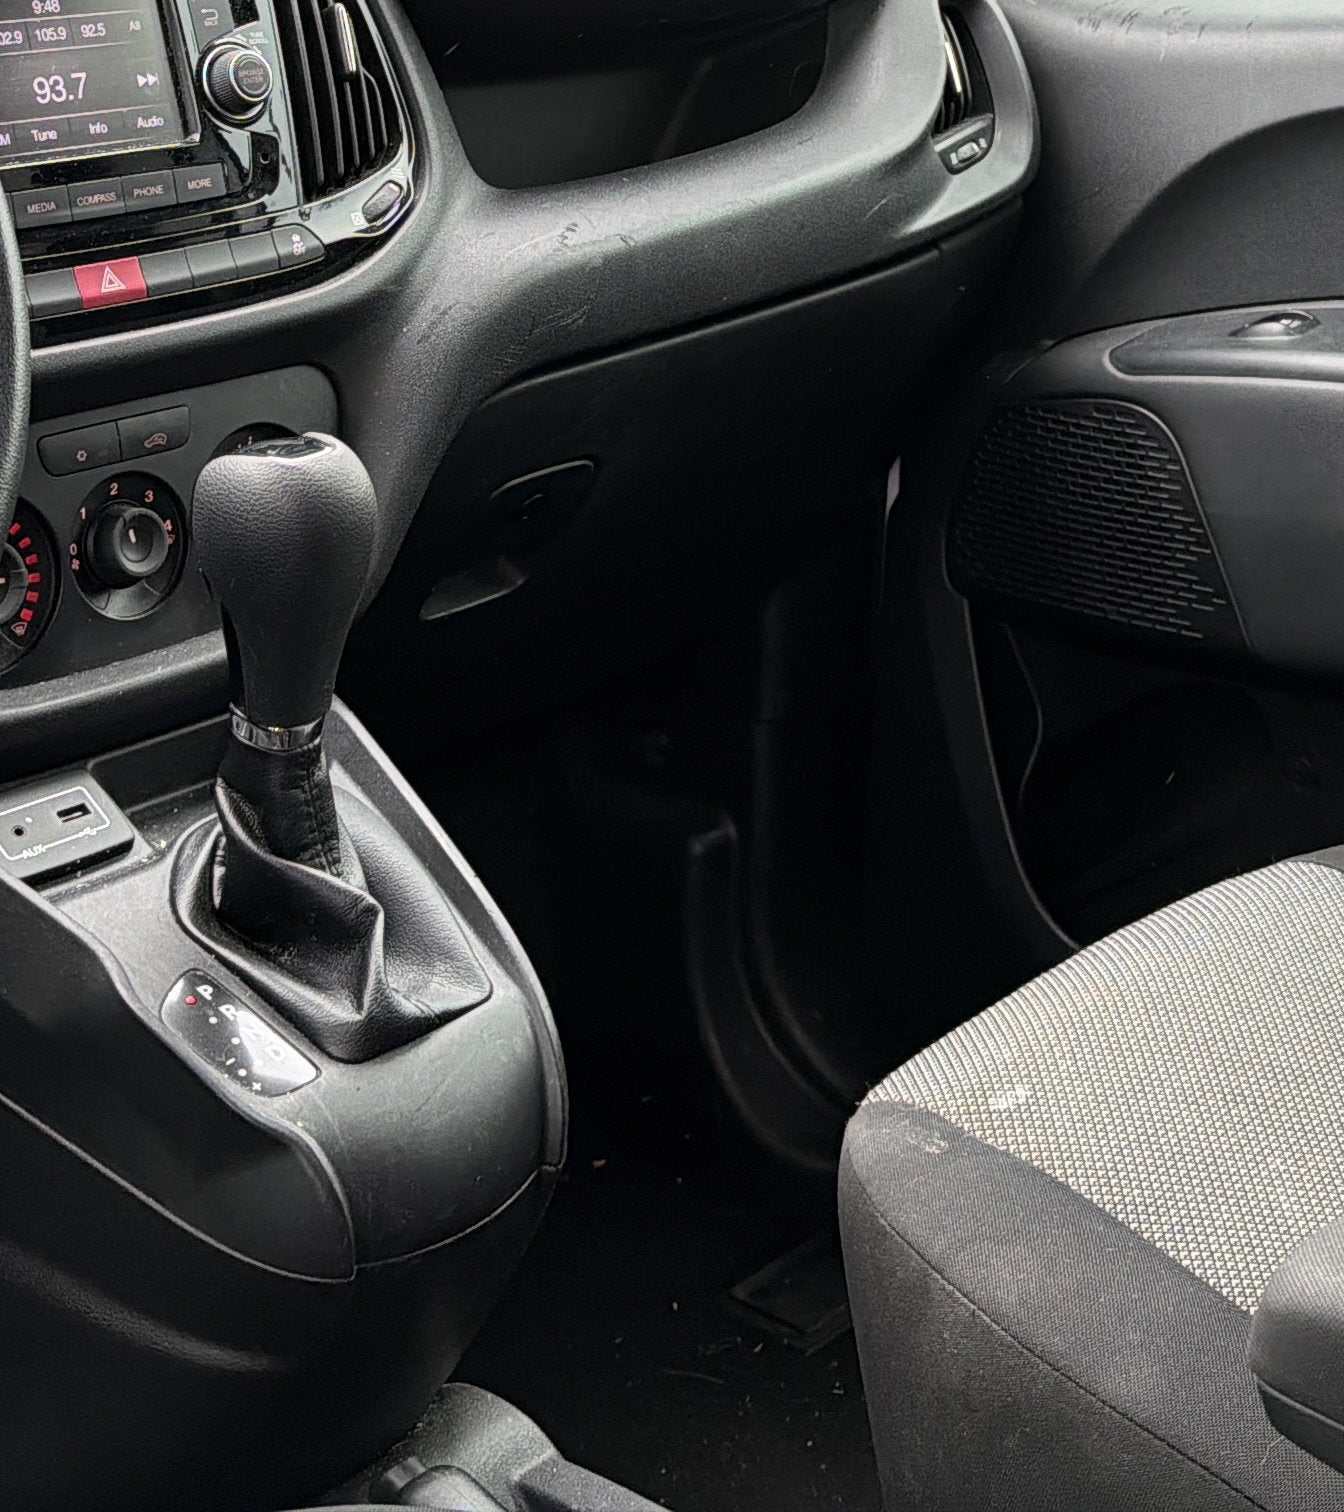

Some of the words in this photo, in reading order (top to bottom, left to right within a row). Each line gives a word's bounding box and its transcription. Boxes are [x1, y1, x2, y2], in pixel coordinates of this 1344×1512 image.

[34, 26, 67, 41] 105.9
[80, 22, 106, 38] 92.5
[32, 72, 87, 104] 93.7
[31, 129, 57, 142] Tune
[89, 121, 108, 135] Info
[137, 116, 164, 129] Audio
[27, 201, 57, 214] MEDIA
[77, 192, 117, 207] COMPASS
[133, 185, 164, 197] PHONE
[187, 177, 212, 189] MORE
[110, 482, 119, 496] 2
[144, 489, 154, 503] 3
[79, 506, 86, 520] 1
[163, 519, 173, 532] 4
[69, 543, 78, 556] 0
[196, 984, 214, 1001] P
[218, 1003, 237, 1021] R
